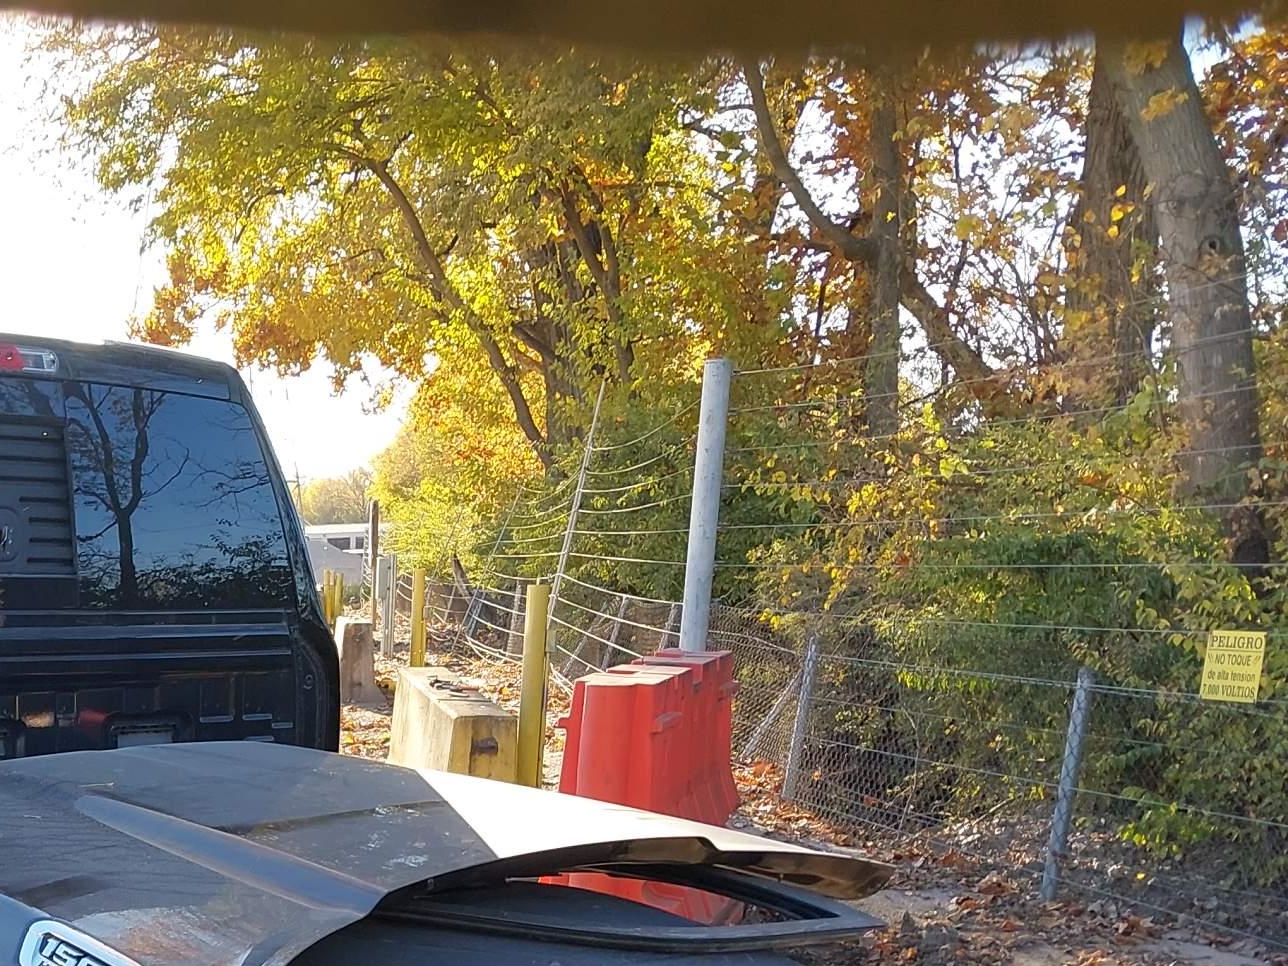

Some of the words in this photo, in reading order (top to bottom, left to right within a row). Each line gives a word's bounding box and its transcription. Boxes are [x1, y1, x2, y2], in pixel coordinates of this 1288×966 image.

[1211, 635, 1263, 650] PELIGRO
[1214, 653, 1226, 665] NO
[1227, 654, 1252, 666] TOQUE
[1221, 684, 1256, 698] VOLTIOS
